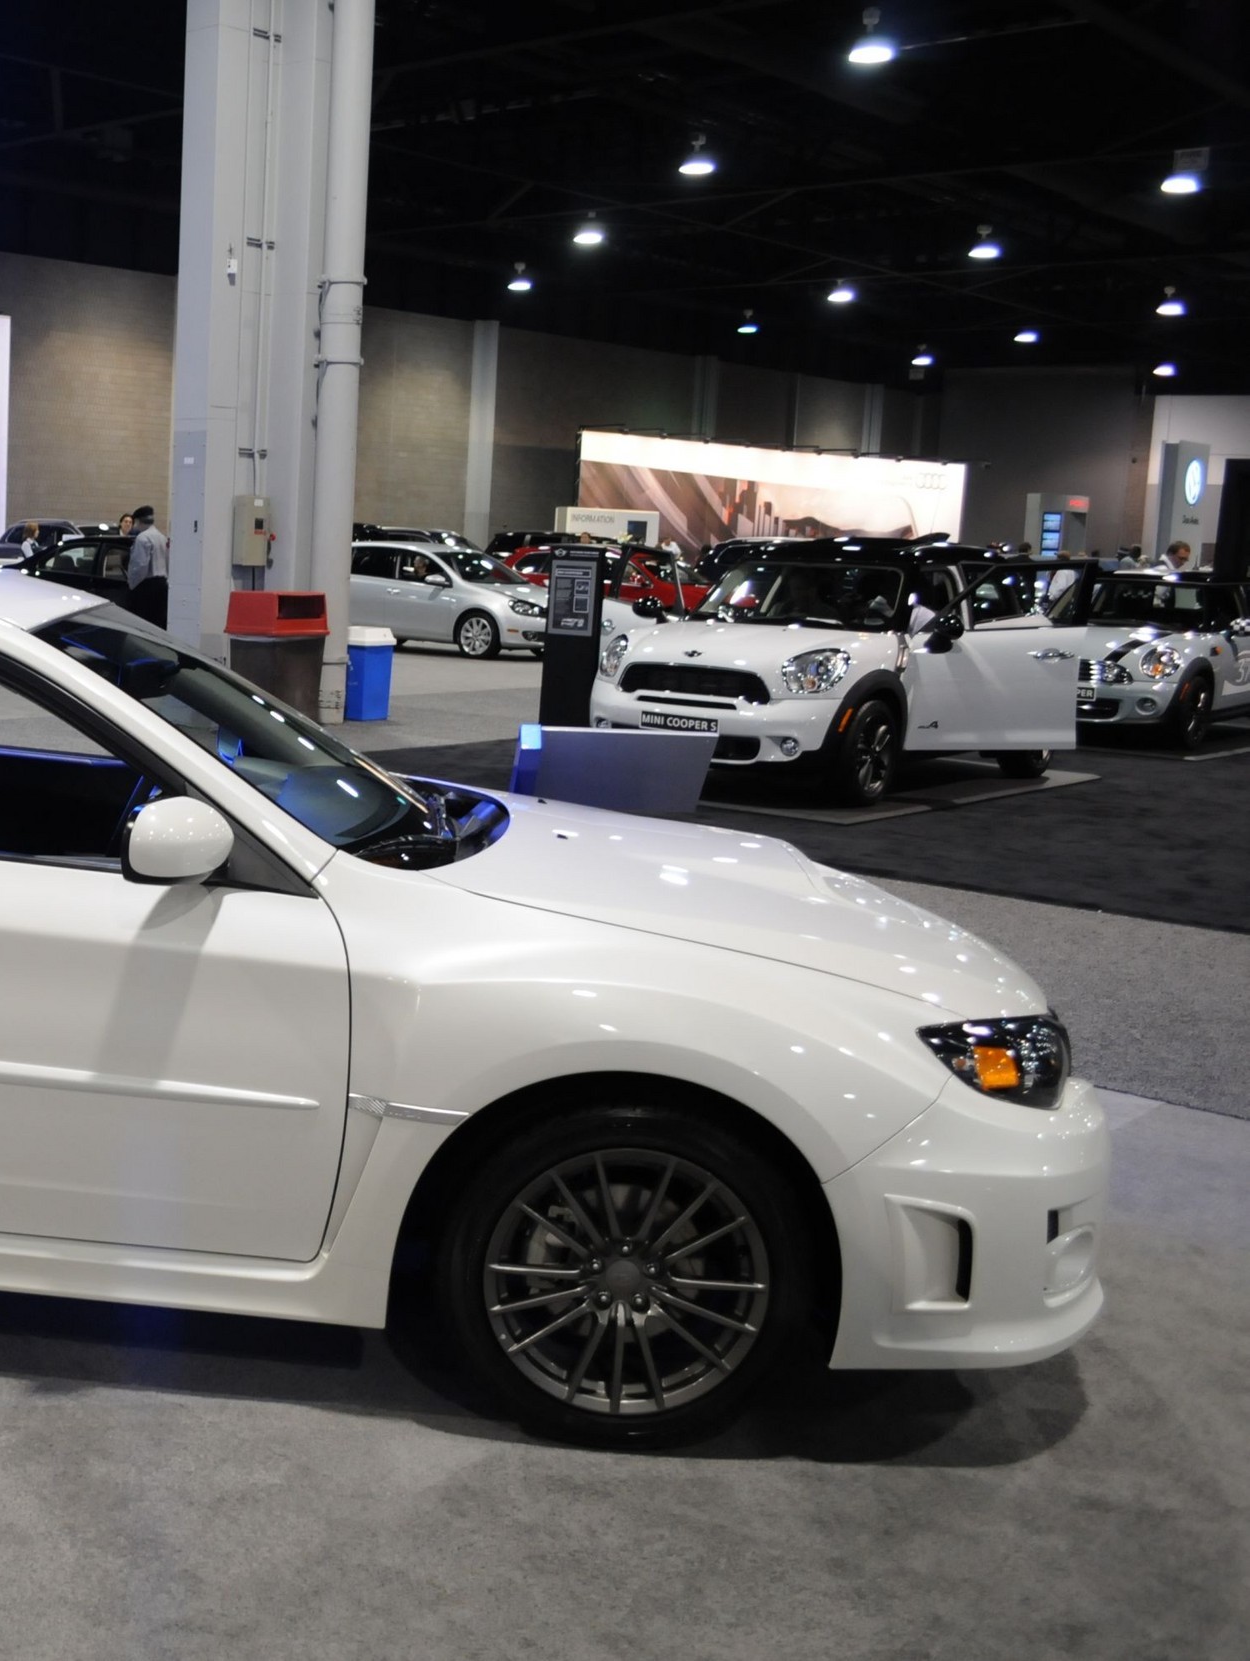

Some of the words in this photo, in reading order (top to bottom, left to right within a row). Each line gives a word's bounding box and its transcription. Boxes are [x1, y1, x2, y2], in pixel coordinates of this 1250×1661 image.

[642, 713, 665, 725] MINI
[666, 716, 708, 730] COOPER
[710, 721, 717, 732] S
